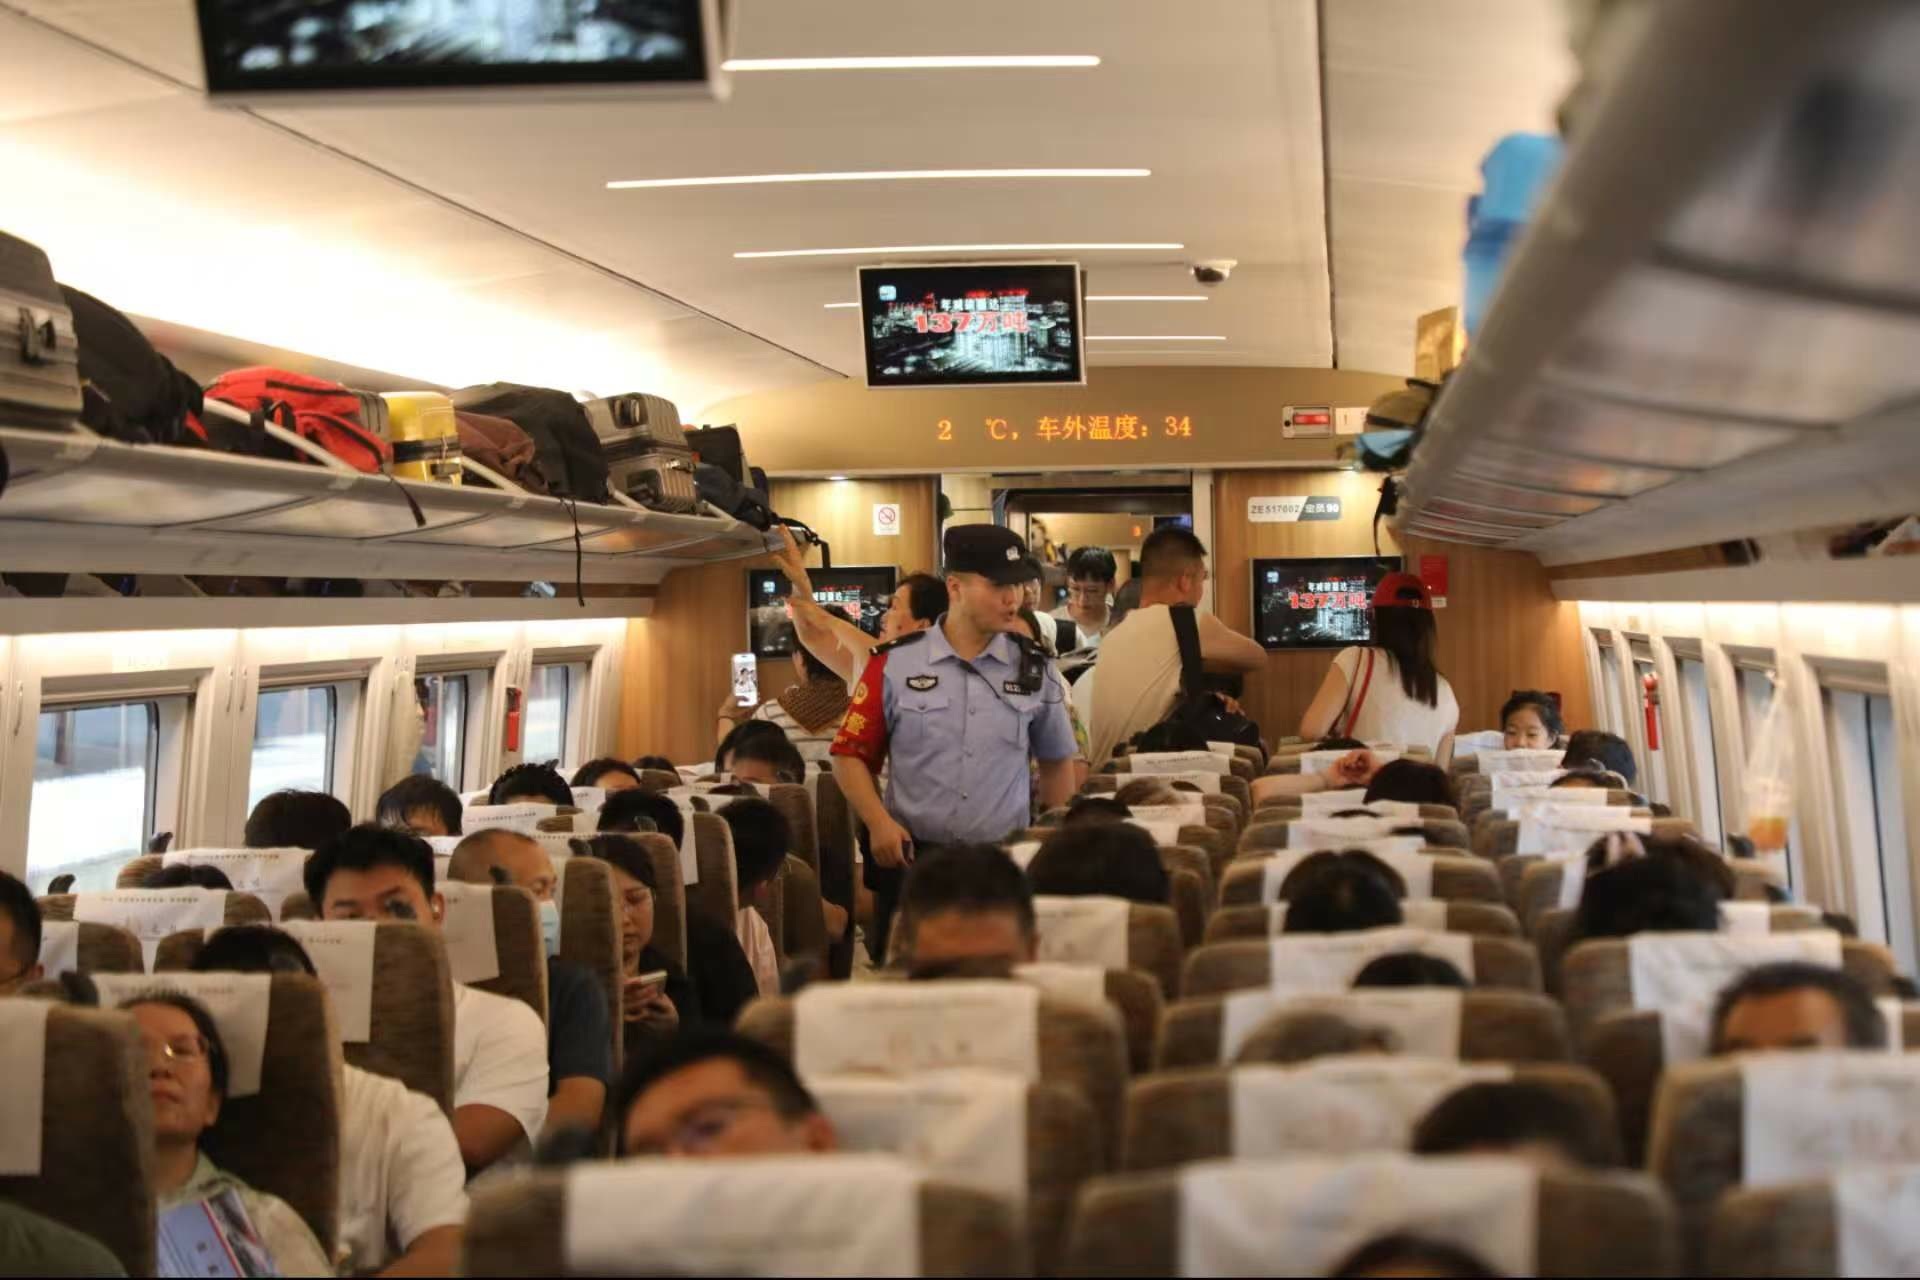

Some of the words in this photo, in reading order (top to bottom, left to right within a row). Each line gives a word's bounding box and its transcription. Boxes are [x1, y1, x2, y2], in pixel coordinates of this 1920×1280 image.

[913, 311, 1029, 334] 137万吨
[937, 419, 952, 440] 2
[1287, 591, 1367, 609] 137万吨
